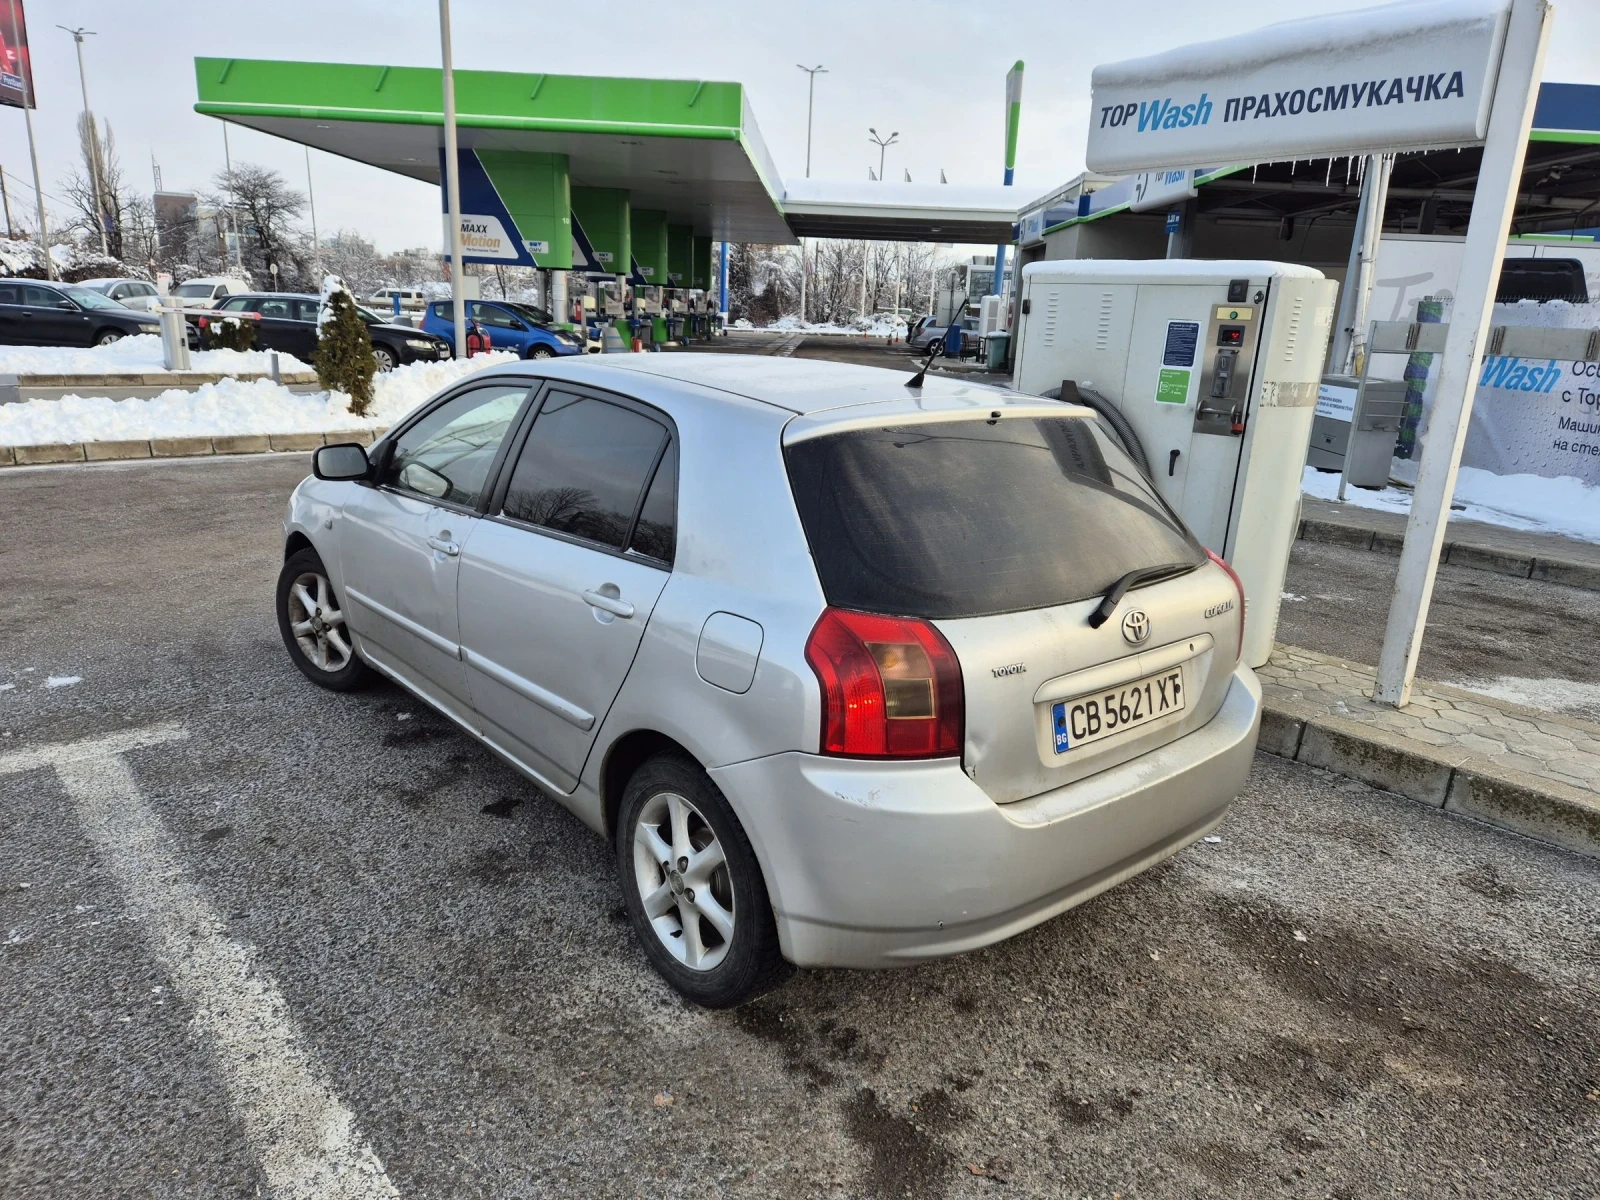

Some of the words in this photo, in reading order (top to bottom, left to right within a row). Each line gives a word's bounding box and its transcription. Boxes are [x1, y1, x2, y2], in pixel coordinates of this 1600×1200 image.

[1223, 71, 1464, 122] ПРАХОСМУКАЧКА
[461, 223, 488, 233] MAXX
[562, 217, 570, 225] 10
[460, 233, 501, 248] Motion
[1480, 356, 1561, 393] Wash
[1553, 440, 1567, 451] на
[1571, 442, 1600, 456] сте
[991, 662, 1027, 678] TOYOTA
[1056, 733, 1067, 745] BG
